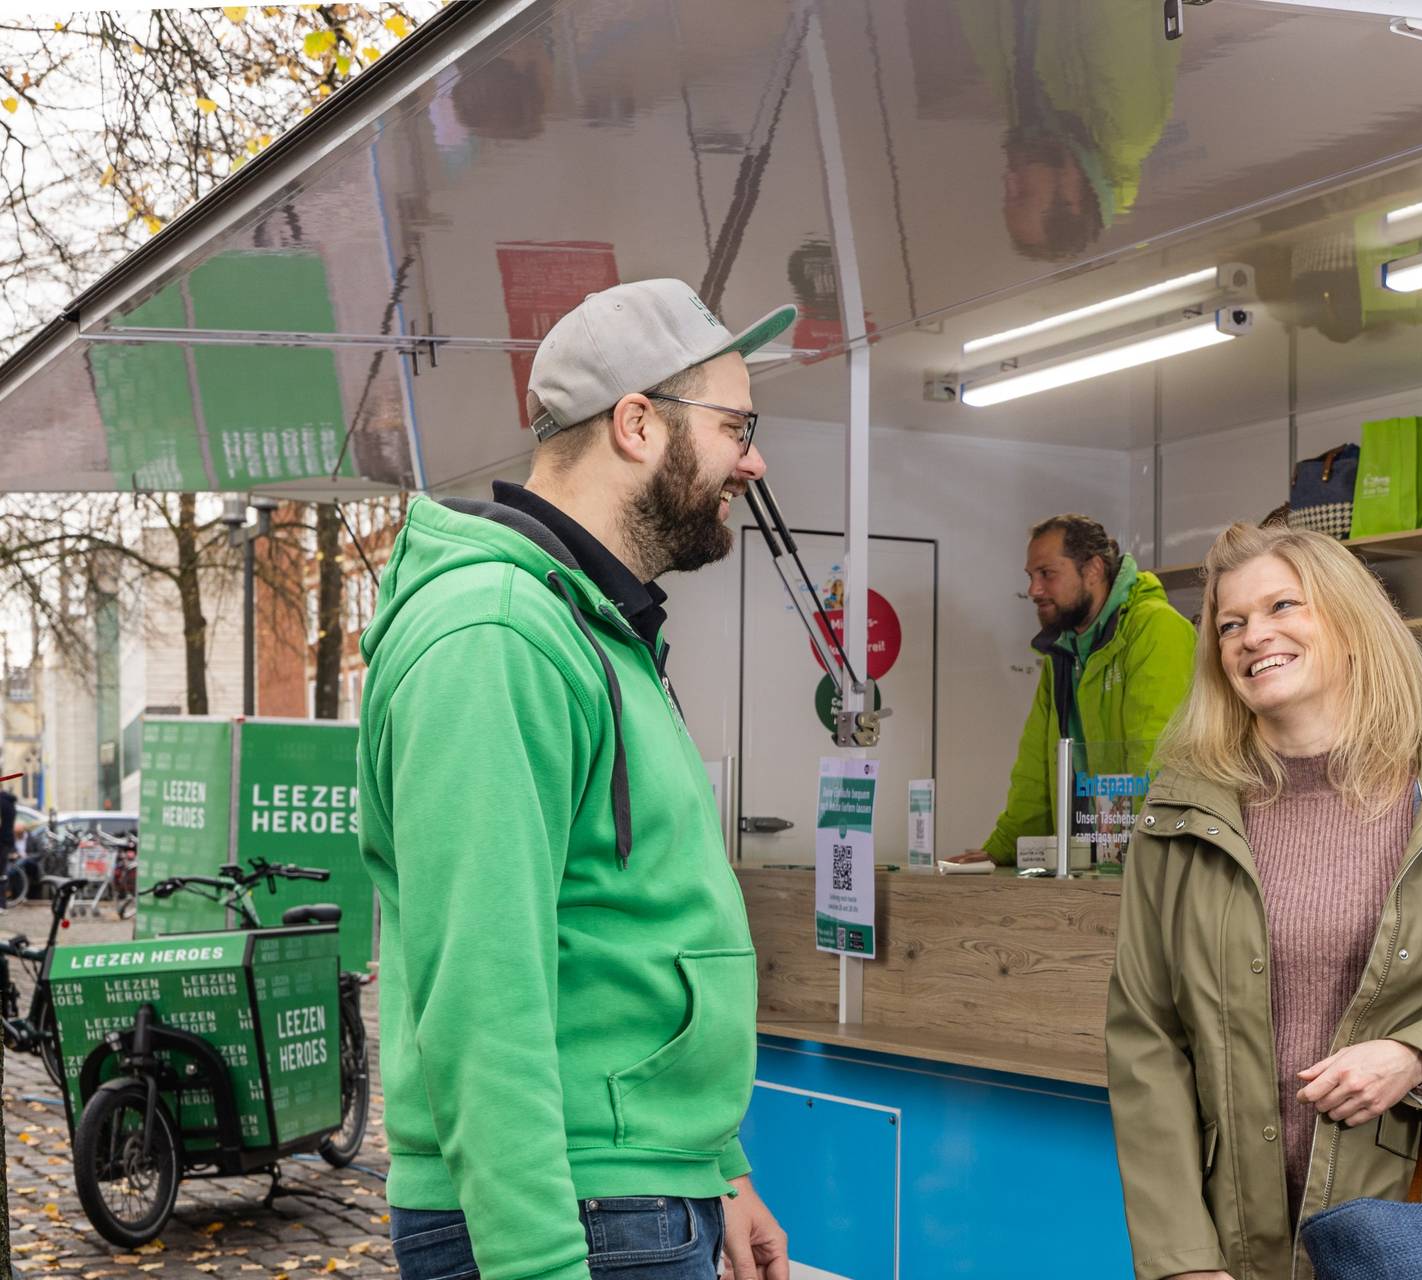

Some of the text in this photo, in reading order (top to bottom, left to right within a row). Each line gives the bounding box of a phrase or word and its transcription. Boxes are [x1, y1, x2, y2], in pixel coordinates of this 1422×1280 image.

[163, 780, 206, 803] LEEZEN
[1076, 771, 1151, 801] Entspannt
[162, 805, 206, 829] HEROES
[252, 811, 359, 834] HEROES
[1076, 810, 1098, 825] Unser
[1075, 832, 1111, 846] samstags
[70, 946, 224, 969] LEEZEN HEROES
[105, 979, 160, 993] LEEZEN
[181, 973, 236, 987] LEEZEN
[51, 983, 83, 995] ZEN
[106, 989, 161, 1004] HEROES
[183, 984, 238, 999] HEROES
[52, 994, 84, 1007] OES
[161, 1010, 216, 1025] LEEZEN
[277, 1006, 326, 1039] LEEZEN
[221, 1044, 247, 1057] ZEN
[279, 1038, 328, 1073] HEROES
